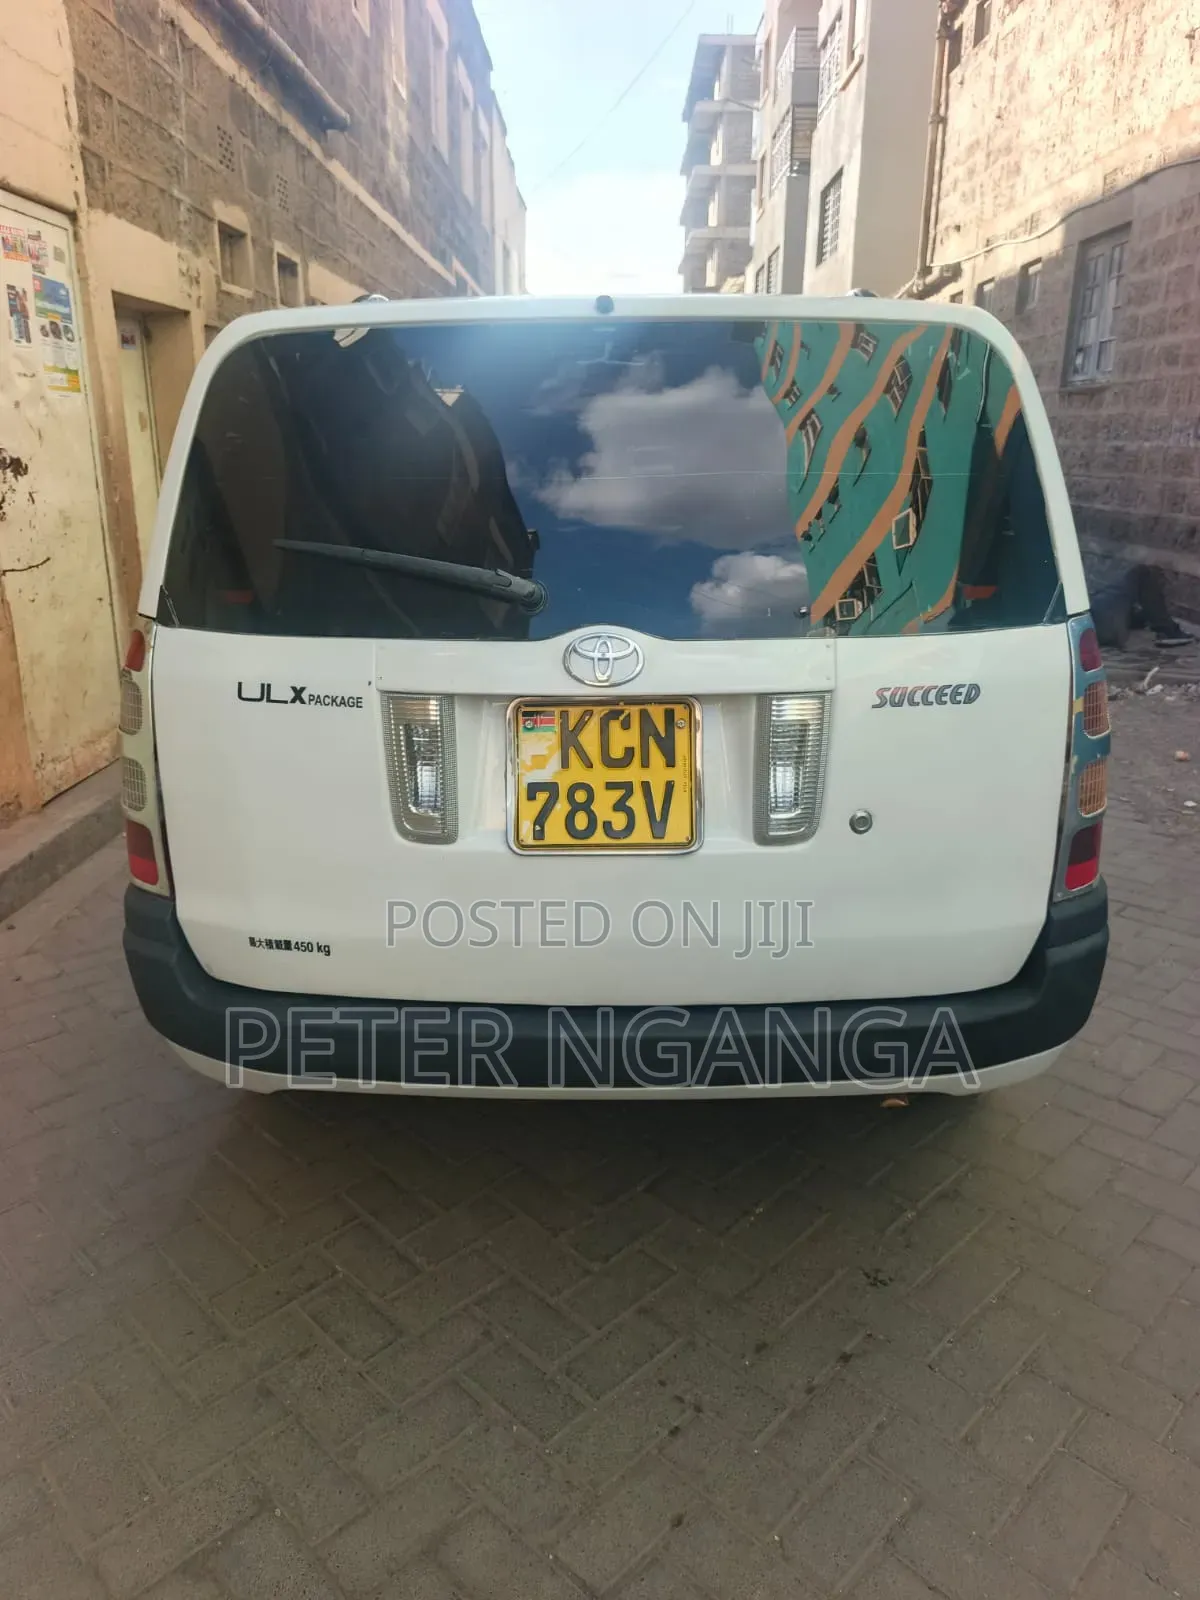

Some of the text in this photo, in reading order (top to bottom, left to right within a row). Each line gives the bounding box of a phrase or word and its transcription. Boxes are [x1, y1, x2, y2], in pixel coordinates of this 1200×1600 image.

[237, 681, 363, 708] ULX PACKAGE
[871, 683, 981, 709] SUCCEED
[559, 708, 676, 769] KCN
[526, 780, 675, 840] 783V
[316, 941, 331, 957] kg
